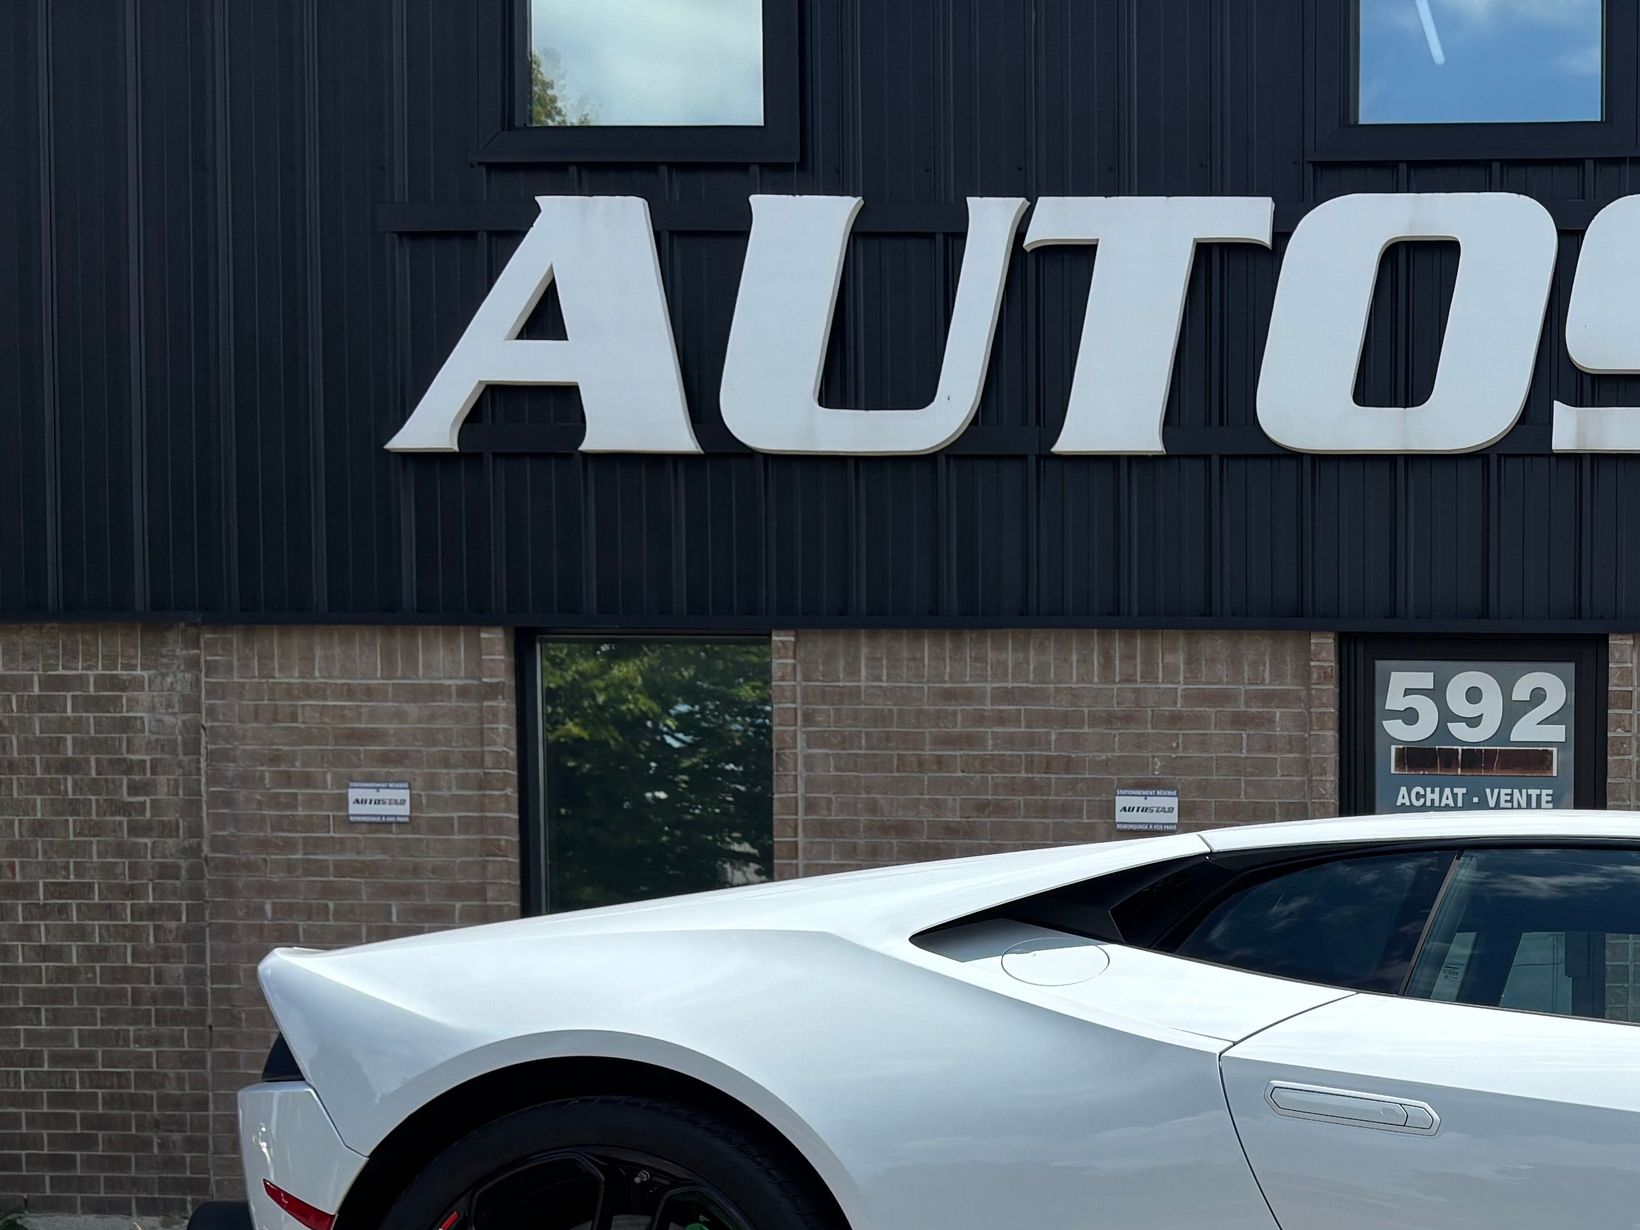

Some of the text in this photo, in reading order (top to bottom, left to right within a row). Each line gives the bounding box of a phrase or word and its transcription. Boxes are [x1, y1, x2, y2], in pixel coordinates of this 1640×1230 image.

[1382, 671, 1567, 743] 592
[1396, 786, 1466, 807] ACHAT
[1485, 788, 1553, 809] VENTE
